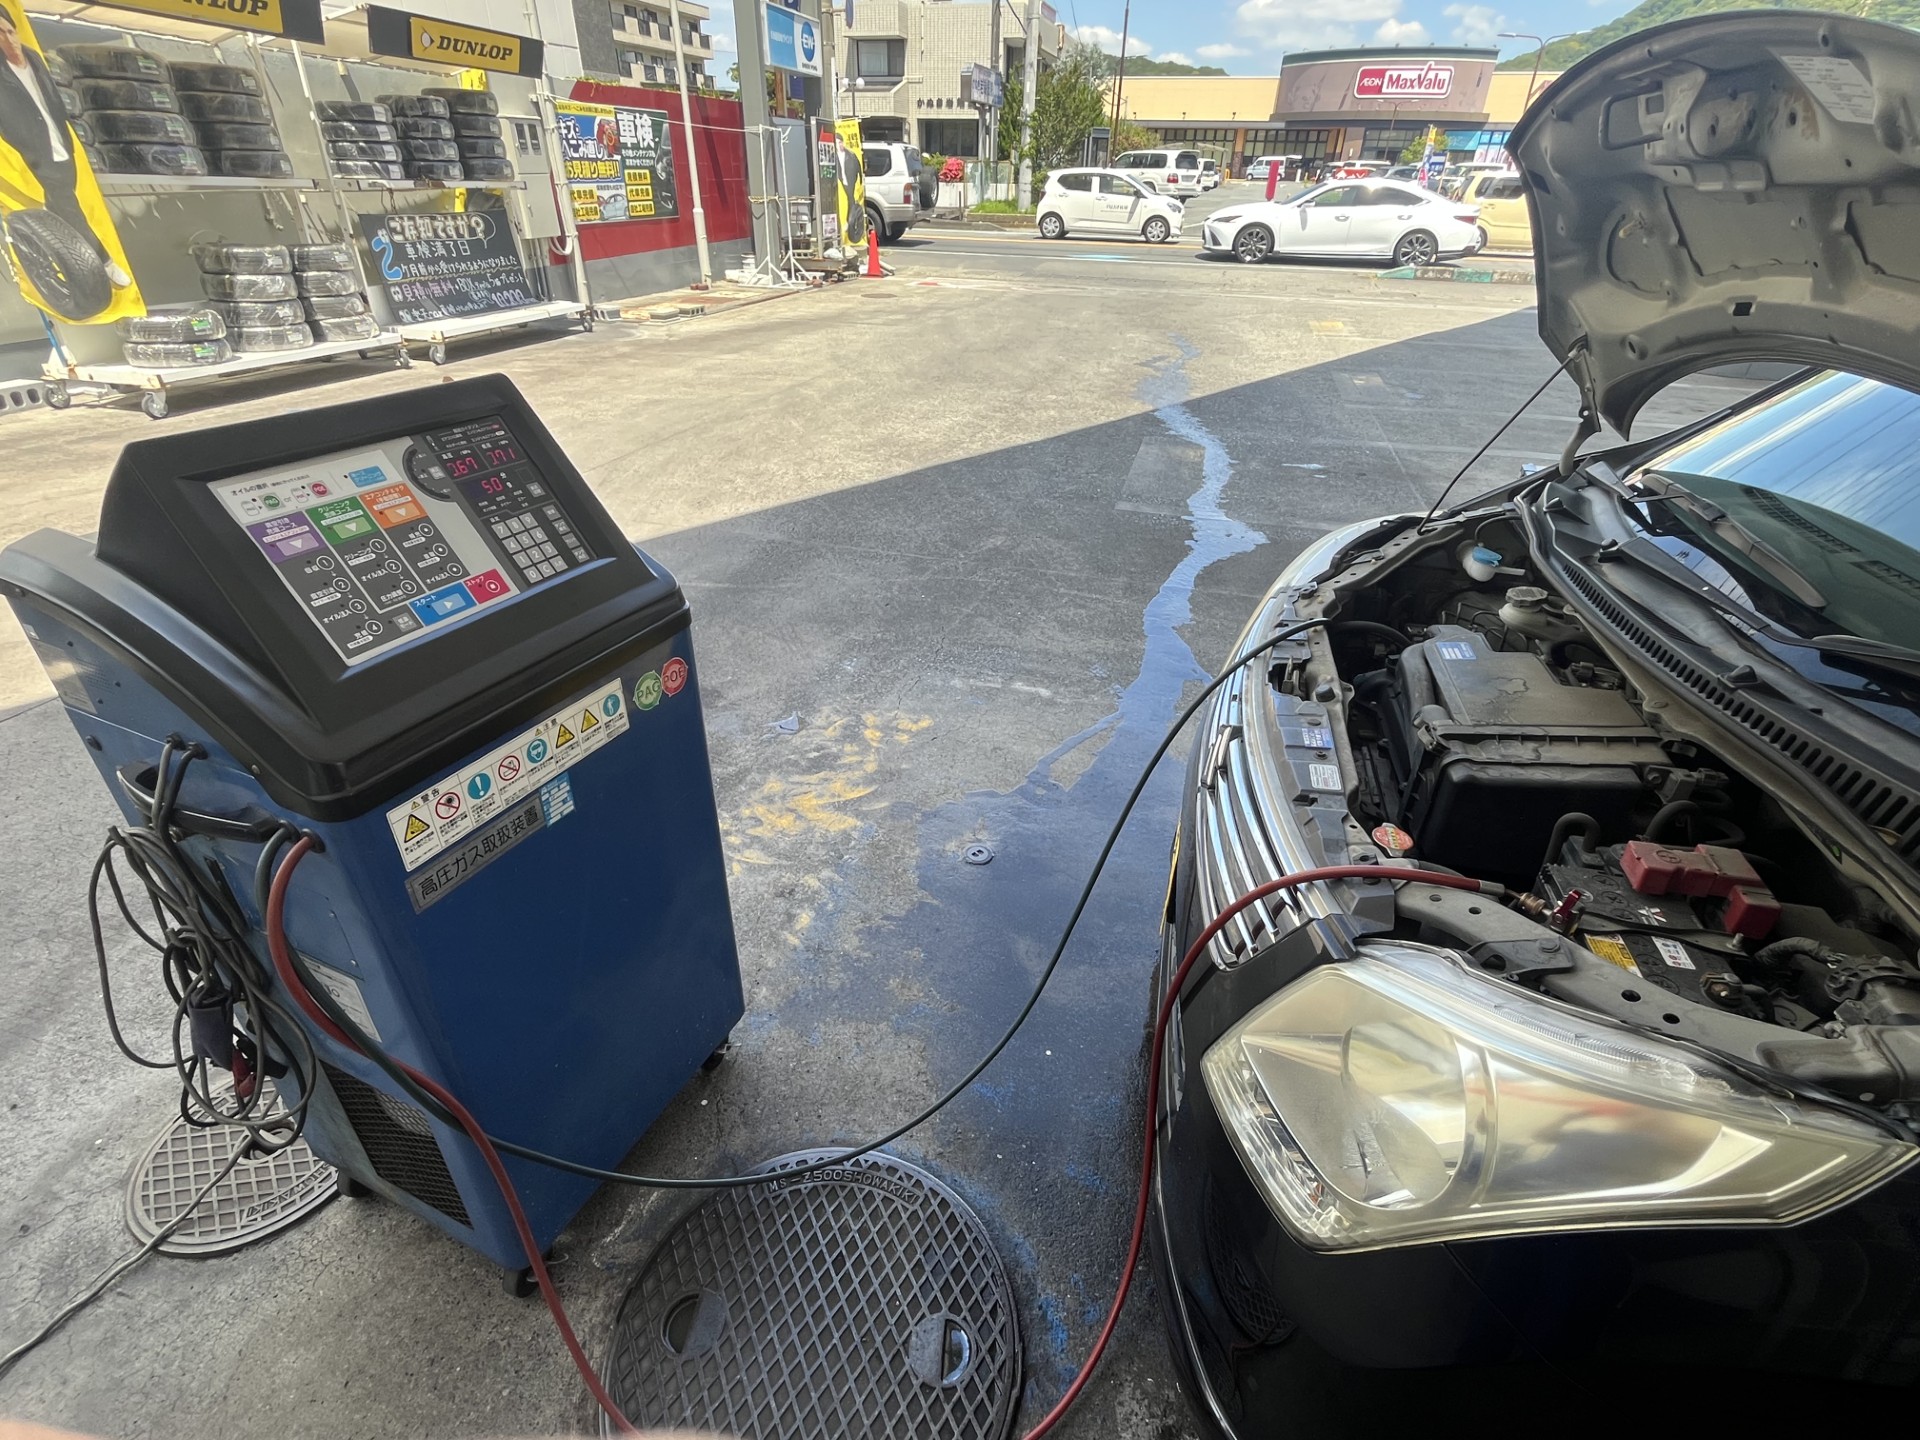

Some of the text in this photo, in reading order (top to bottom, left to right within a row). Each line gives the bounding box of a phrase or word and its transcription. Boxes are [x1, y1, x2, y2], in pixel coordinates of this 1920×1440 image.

[437, 35, 513, 60] DUNLOP
[1386, 64, 1447, 90] MaxValu
[563, 139, 604, 158] へこみ直し
[405, 240, 470, 260] 車検満了日
[481, 477, 503, 494] 50
[318, 501, 351, 514] クリーニング
[344, 548, 373, 560] クリーニング
[466, 577, 485, 586] ストップ
[415, 595, 438, 607] スタート
[637, 667, 685, 701] PAG POE
[418, 805, 539, 900] 高圧ガス取扱装置
